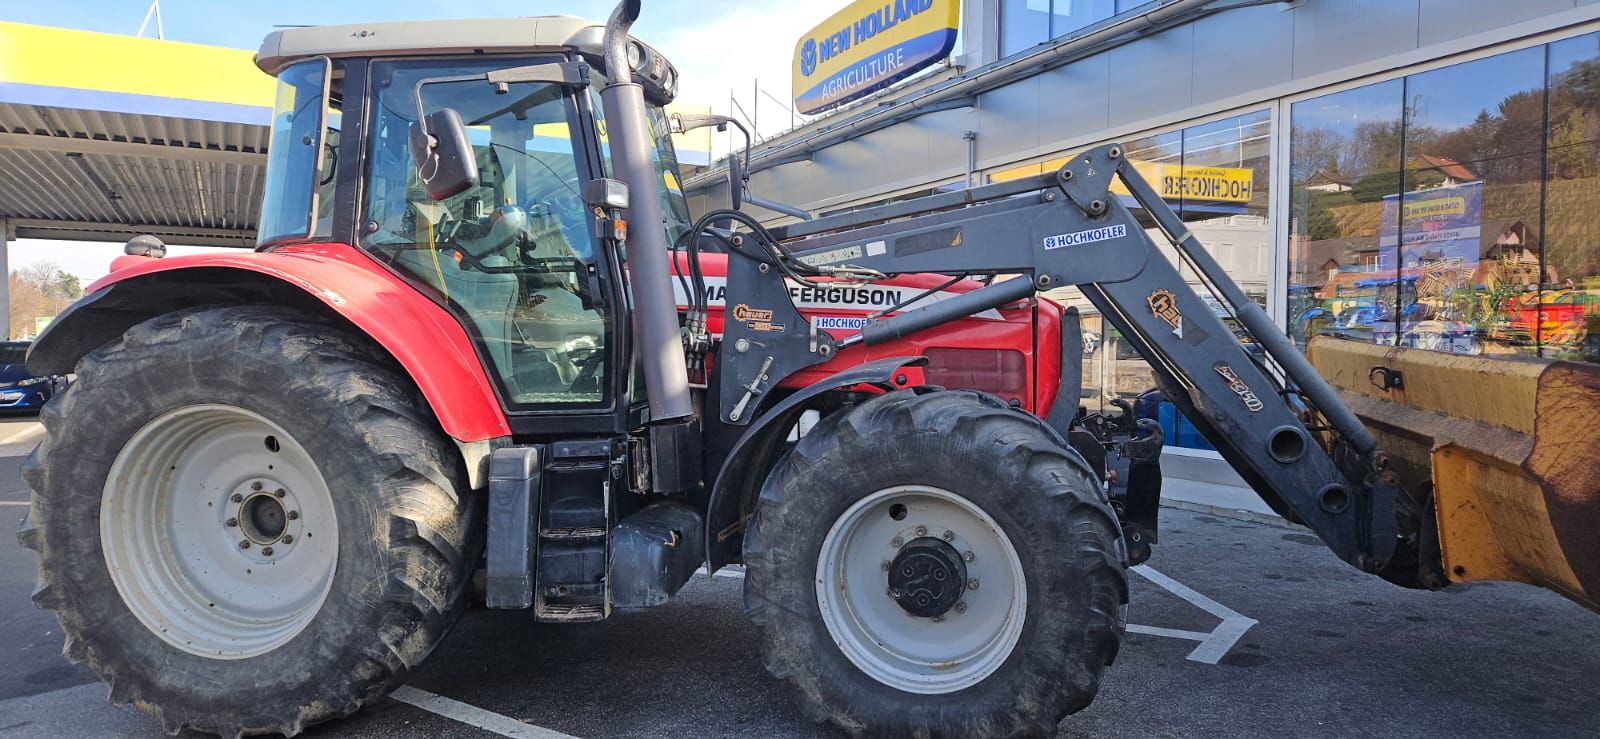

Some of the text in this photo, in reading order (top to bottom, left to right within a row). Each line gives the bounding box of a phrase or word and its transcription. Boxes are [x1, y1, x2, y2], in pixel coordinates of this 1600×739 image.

[819, 28, 850, 63] NEW
[821, 48, 904, 101] AGRICULTURE
[1058, 226, 1124, 246] HOCHKOFLER
[790, 288, 901, 305] FERGUSON
